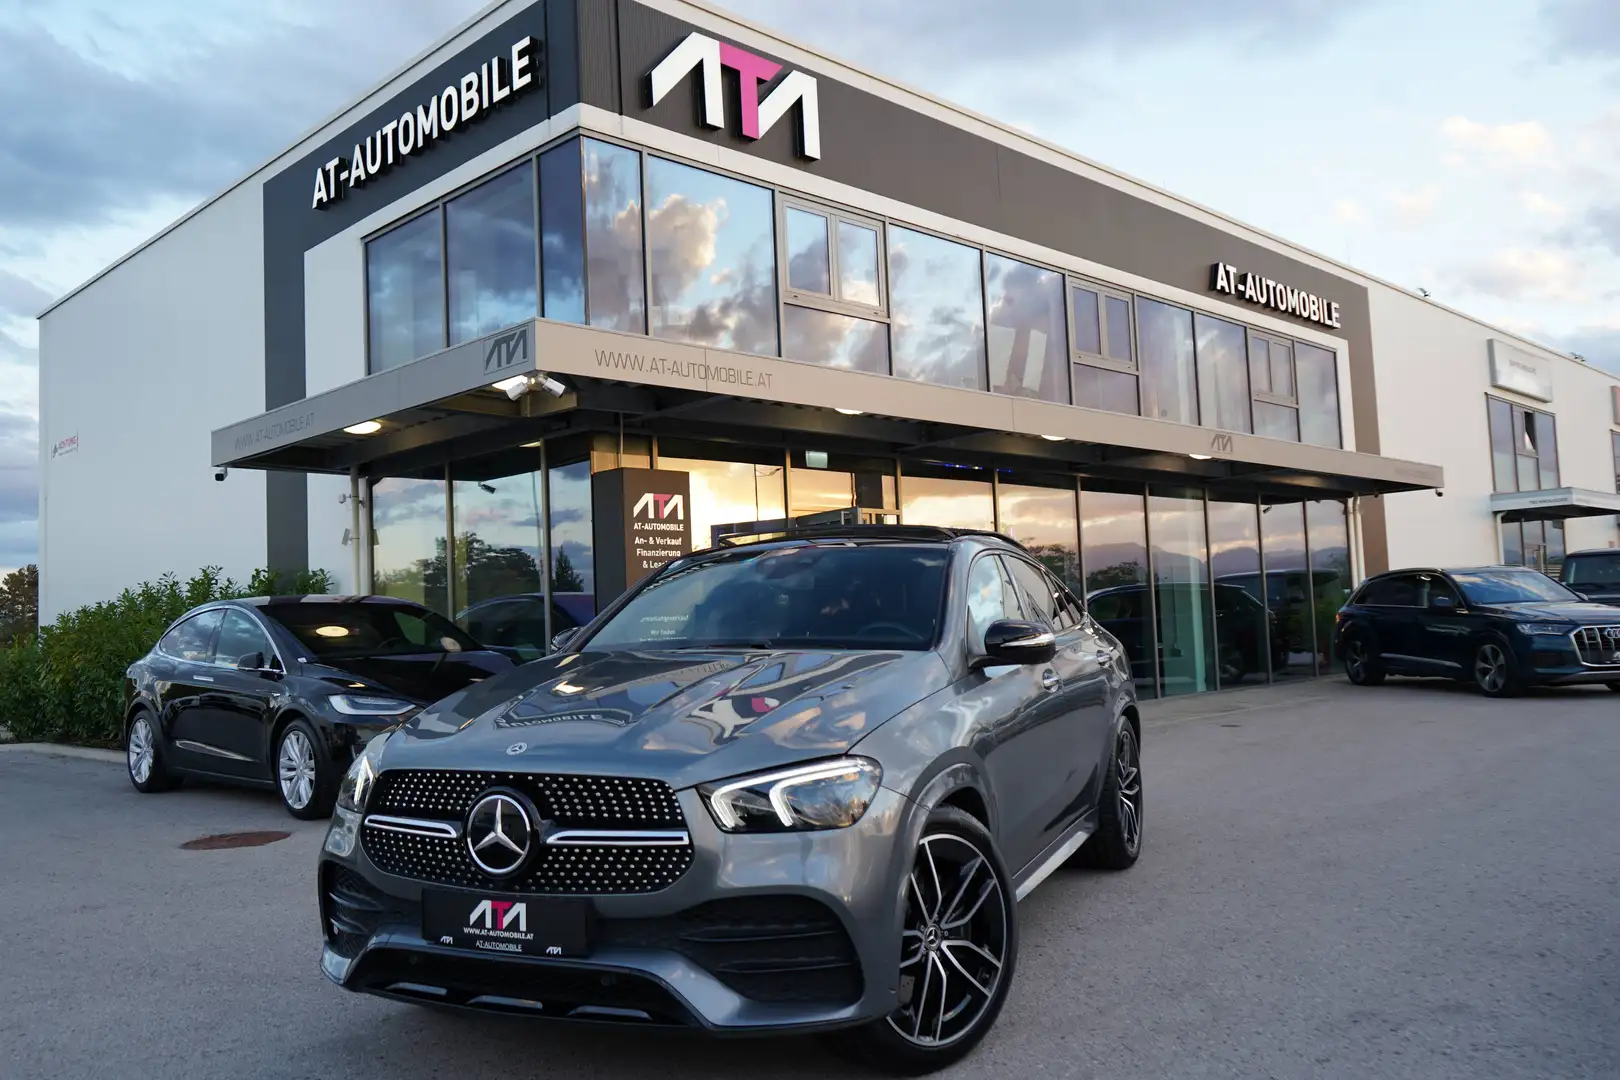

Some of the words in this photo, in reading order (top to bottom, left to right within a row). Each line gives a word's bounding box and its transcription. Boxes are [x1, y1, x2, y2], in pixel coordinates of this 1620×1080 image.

[651, 31, 821, 160] ATA
[312, 36, 532, 209] AT-AUTOMOBILE
[1216, 262, 1341, 328] AT-AUTOMOBILE
[595, 350, 773, 389] WWW.AT-AUTOMOBILE.AT
[633, 493, 684, 520] ATA
[633, 522, 684, 532] AT-AUTOMOBILE
[634, 536, 648, 545] An-
[649, 536, 654, 545] &
[655, 536, 682, 546] Verkauf
[642, 560, 649, 568] &
[469, 899, 527, 932] ATA
[463, 927, 534, 940] WWW.AT-AUTOMOBILE.AT
[475, 940, 523, 951] AT-AUTOMOBILE
